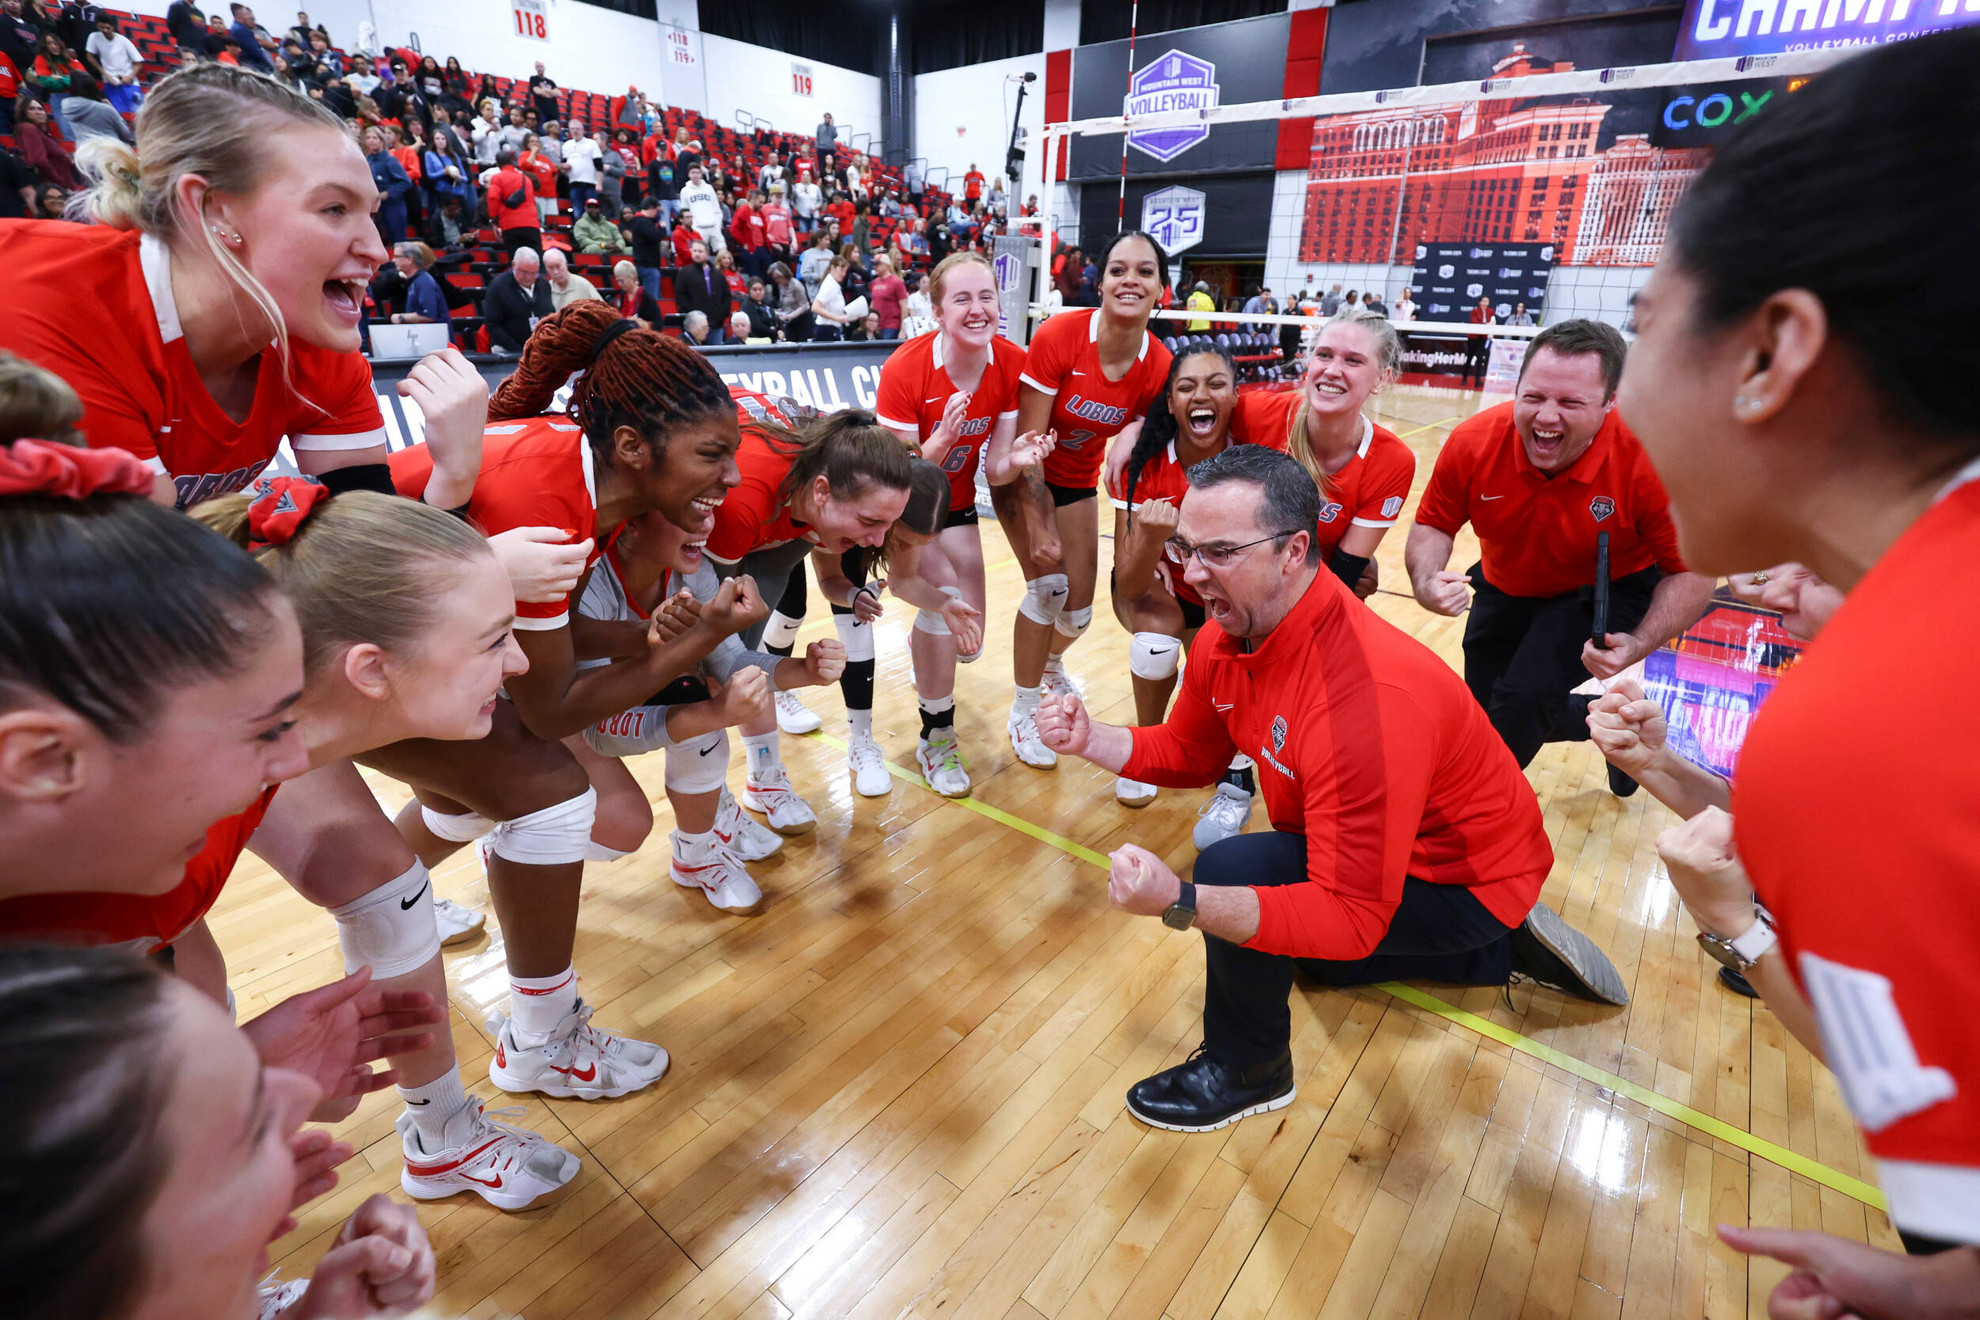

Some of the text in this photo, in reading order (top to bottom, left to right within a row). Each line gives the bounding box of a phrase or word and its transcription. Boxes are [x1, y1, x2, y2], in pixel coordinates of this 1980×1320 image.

[515, 9, 546, 39] 118
[672, 32, 688, 46] 118
[1784, 36, 1878, 51] VOLLEYBALL
[674, 50, 689, 63] 119
[1754, 59, 1775, 68] WEST
[793, 73, 812, 95] 119
[1141, 77, 1203, 92] MOUNTAIN WEST
[1130, 92, 1207, 115] VOLLEYBALL
[1663, 90, 1773, 130] COX
[1149, 206, 1199, 234] 25
[1400, 349, 1485, 368] akingHerM
[1065, 394, 1128, 426] LOBOS
[1060, 429, 1096, 451] 2
[942, 445, 972, 472] 6
